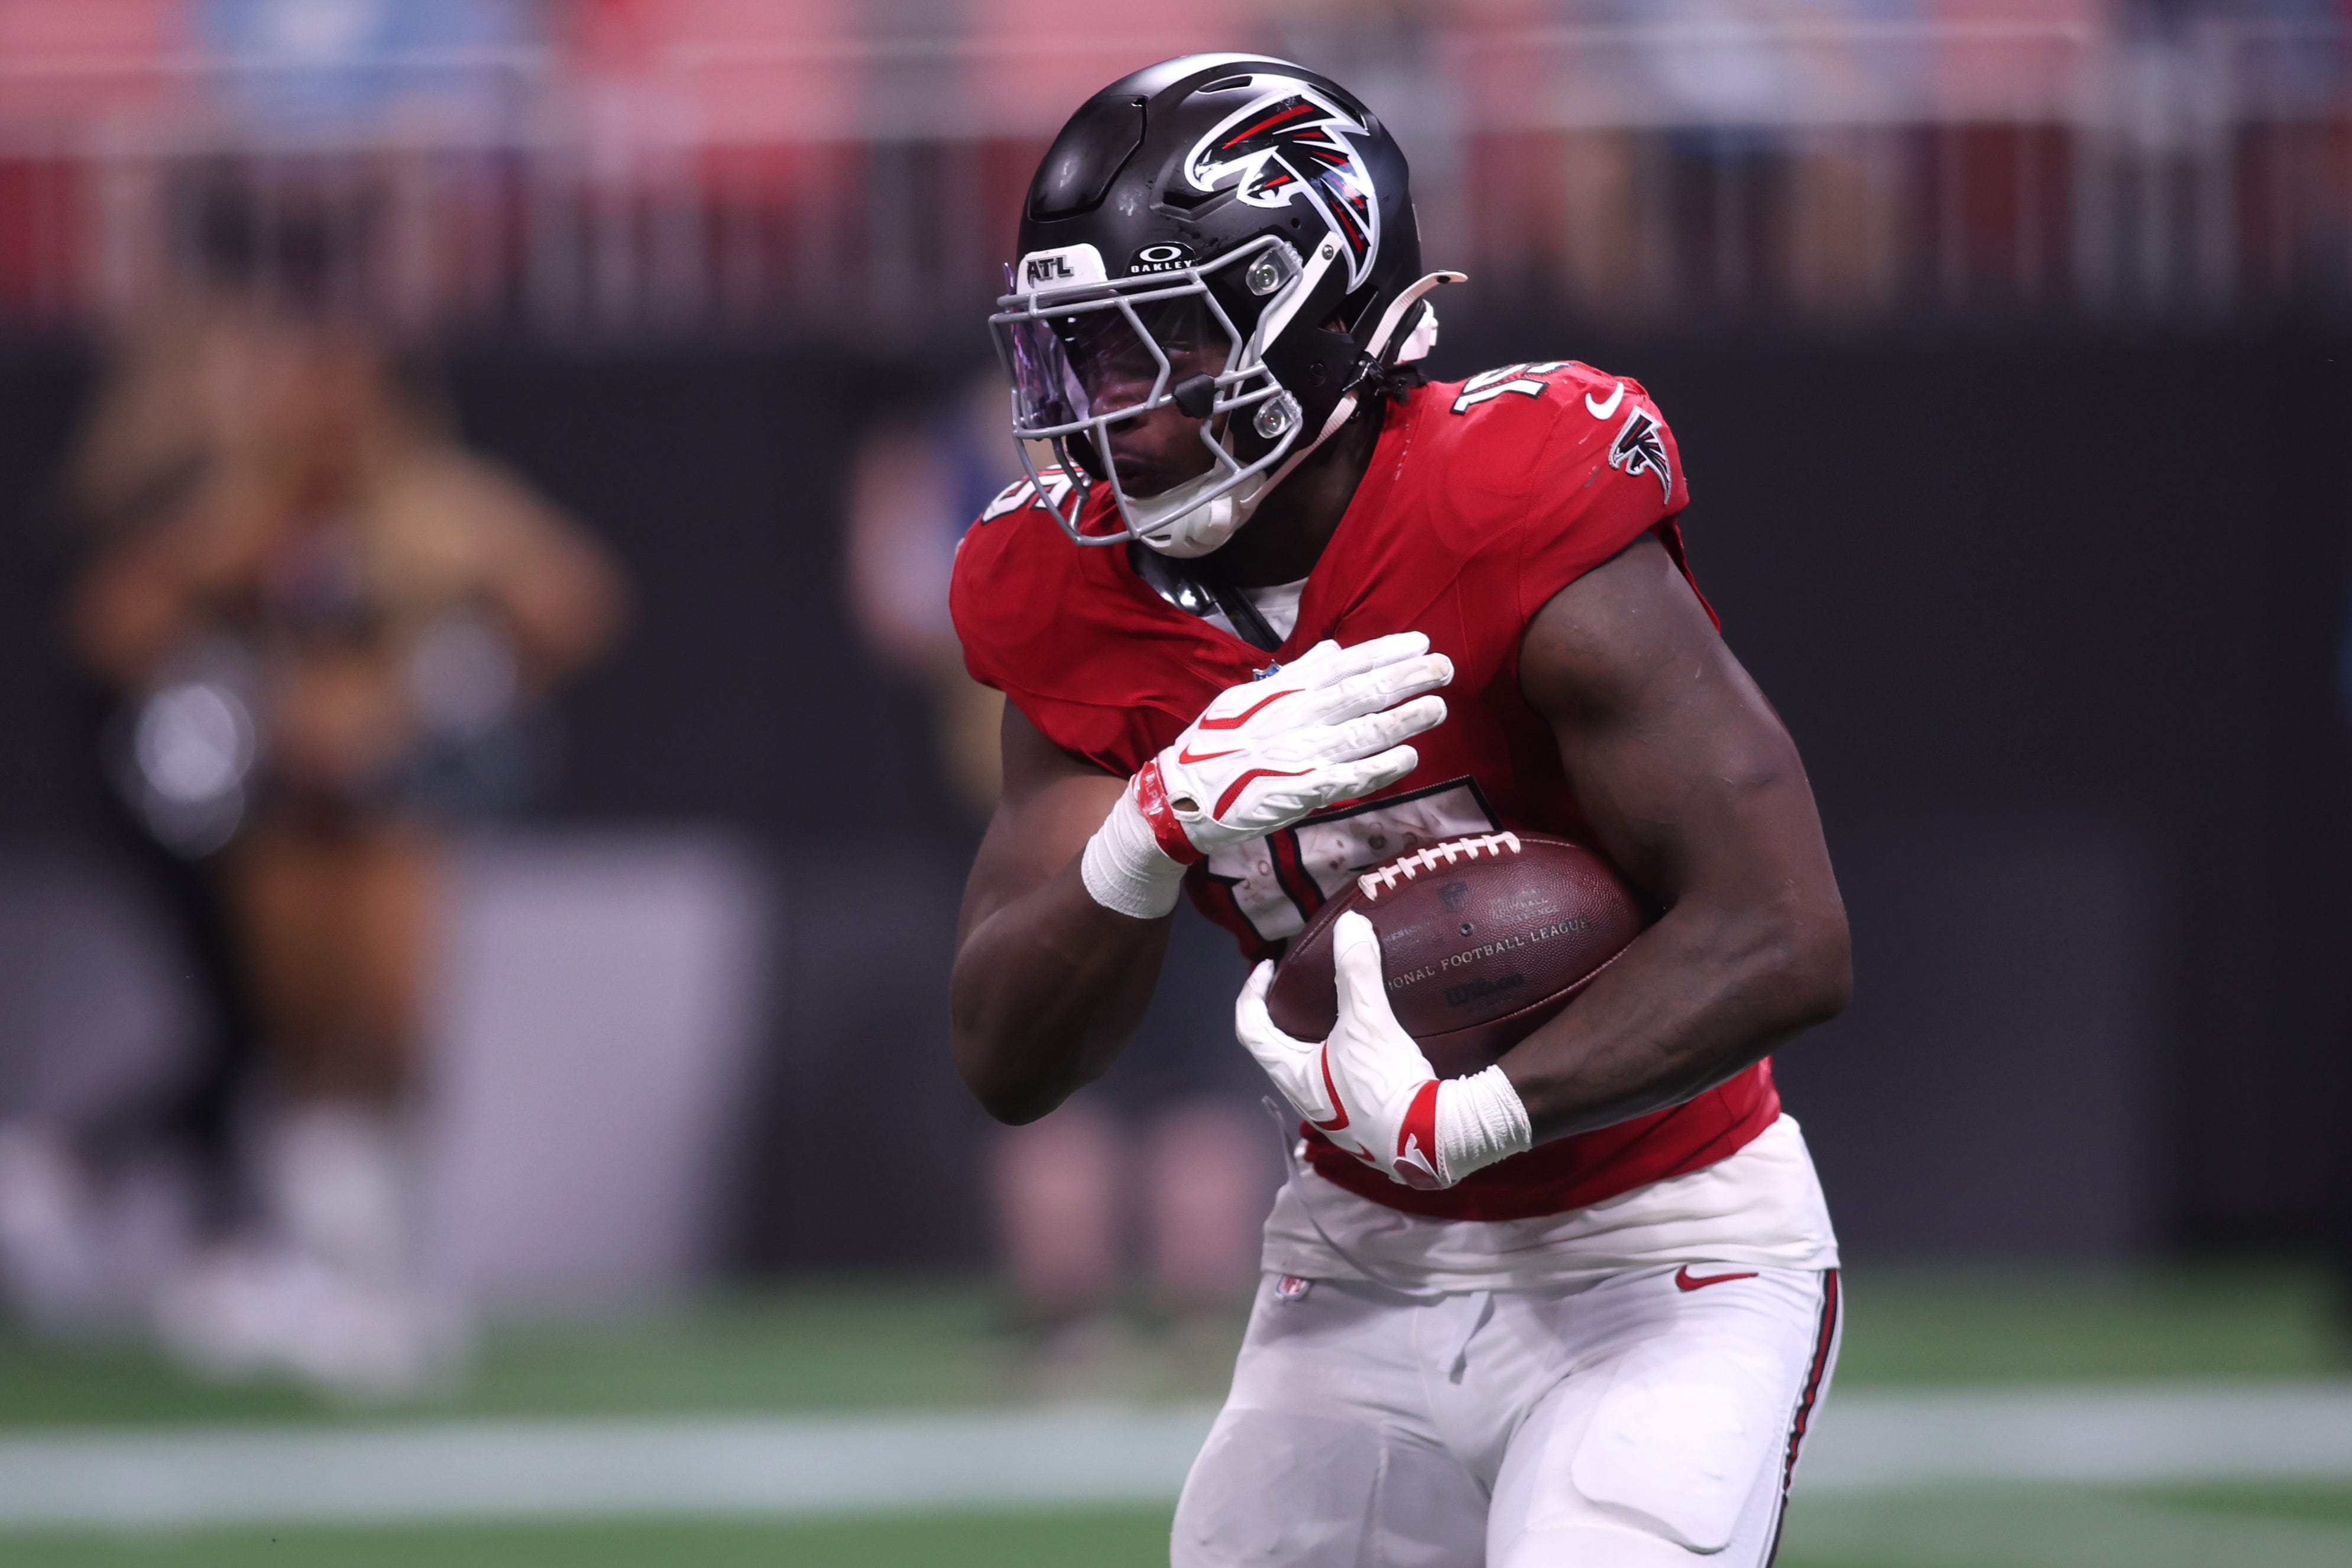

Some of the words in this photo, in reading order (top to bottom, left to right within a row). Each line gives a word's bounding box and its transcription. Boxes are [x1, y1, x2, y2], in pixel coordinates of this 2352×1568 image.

[1026, 255, 1074, 289] ATL
[1130, 260, 1192, 273] OAKLEY
[1386, 966, 1436, 991] IONAL
[1440, 936, 1525, 971] FOOTBALL
[1530, 918, 1589, 942] LEAGUE
